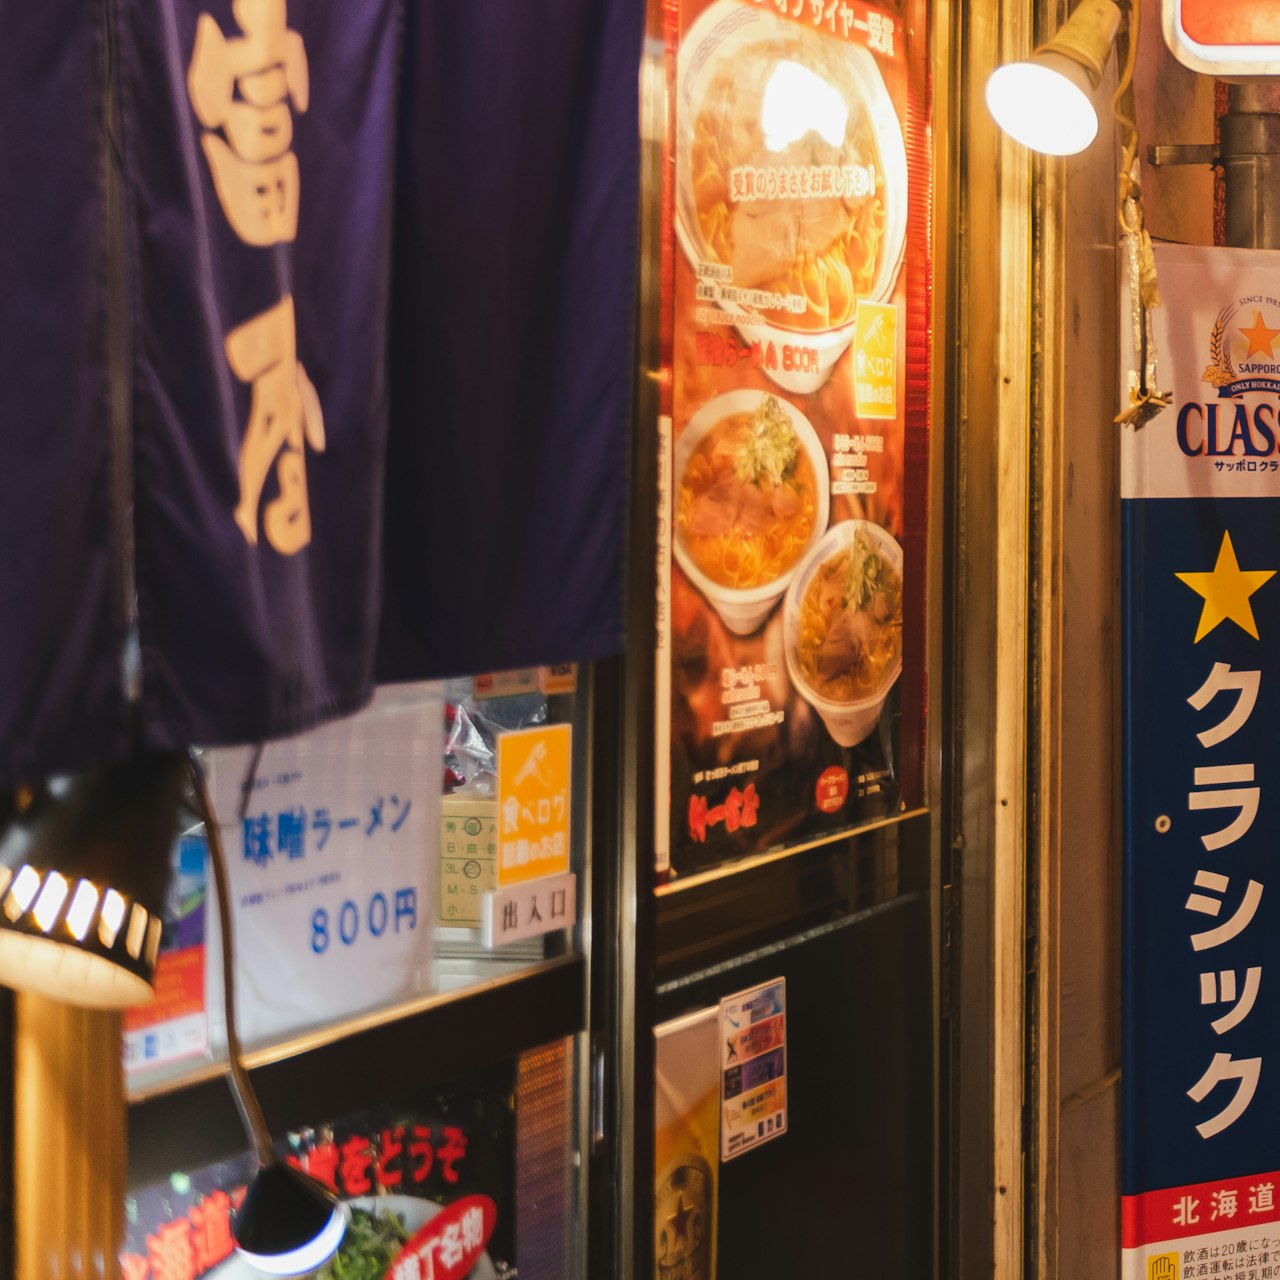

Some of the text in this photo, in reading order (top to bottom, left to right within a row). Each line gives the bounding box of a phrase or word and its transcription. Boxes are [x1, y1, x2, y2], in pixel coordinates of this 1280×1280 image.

[1239, 295, 1263, 306] SINCE
[1230, 381, 1250, 393] ONLY
[241, 793, 412, 867] 味噌ラーメン
[503, 787, 566, 835] 食べログ
[310, 887, 418, 954] 800円
[503, 888, 566, 932] 出入口
[1186, 662, 1264, 1139] クラシック
